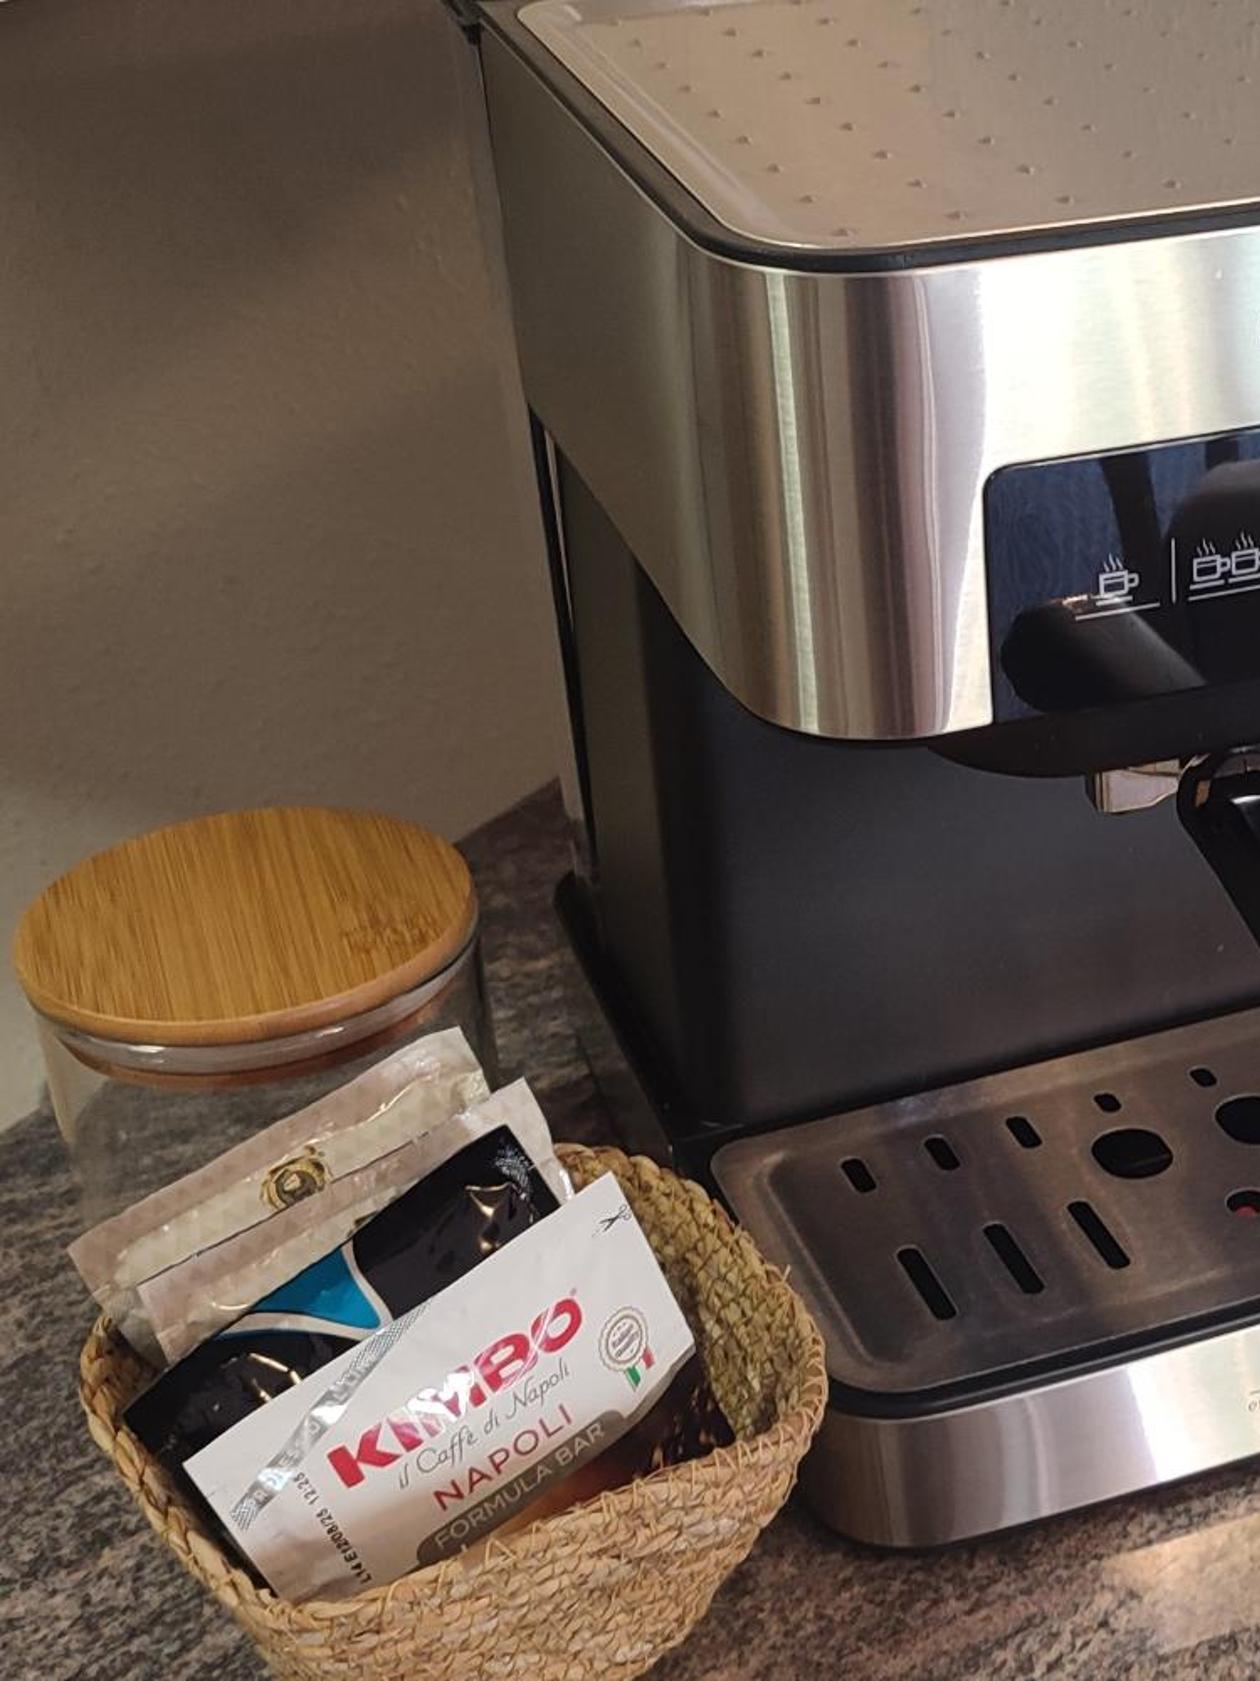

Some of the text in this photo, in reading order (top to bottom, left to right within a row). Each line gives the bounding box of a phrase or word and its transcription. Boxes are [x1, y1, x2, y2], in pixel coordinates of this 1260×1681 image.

[327, 1298, 583, 1488] KIMBO
[416, 1421, 480, 1474] Caffè
[484, 1409, 499, 1436] di
[507, 1357, 570, 1420] Napoli
[433, 1403, 573, 1512] NAPOLI
[434, 1421, 607, 1551] FORMULA BAR
